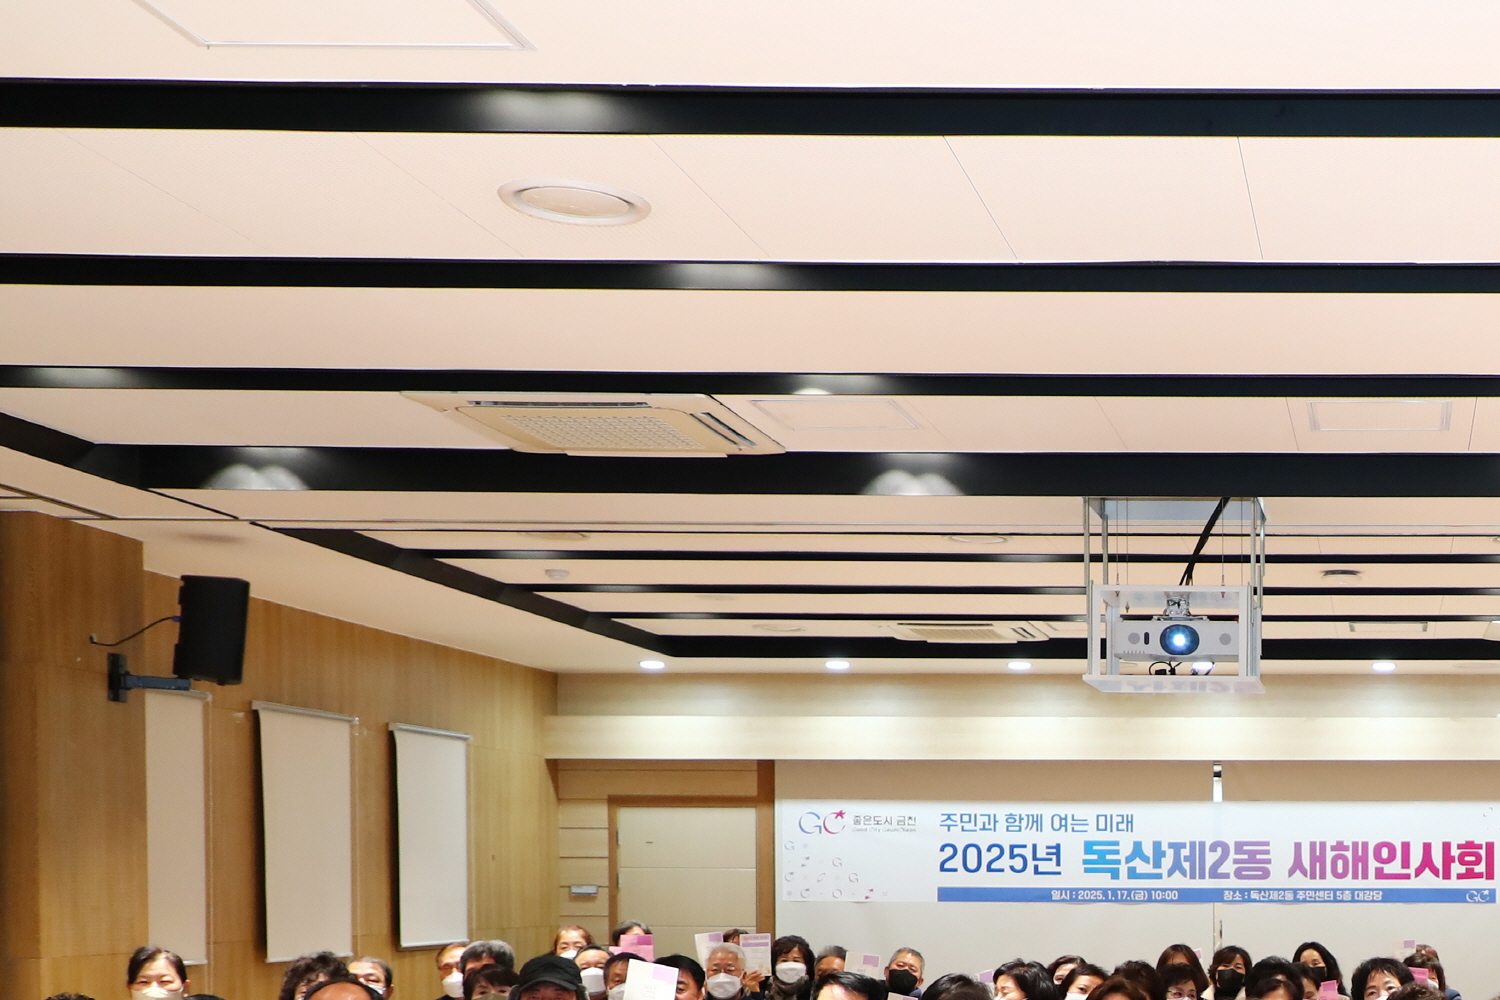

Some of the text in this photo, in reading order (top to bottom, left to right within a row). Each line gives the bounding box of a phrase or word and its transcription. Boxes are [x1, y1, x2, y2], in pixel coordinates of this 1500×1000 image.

[852, 815, 916, 826] 좋은도시 금천
[940, 813, 1134, 832] 주민과 함께 여는 미래
[939, 840, 1495, 880] 2025년 독산제2동 새해인사회
[1051, 890, 1070, 900] 일시
[1078, 890, 1106, 900] 2025.
[1151, 890, 1178, 900] 10:00
[1223, 890, 1243, 900] 장소
[1250, 890, 1294, 900] 독산제2동
[1296, 890, 1334, 900] 주민센터
[1336, 890, 1352, 900] 5층
[1354, 890, 1383, 900] 대강당
